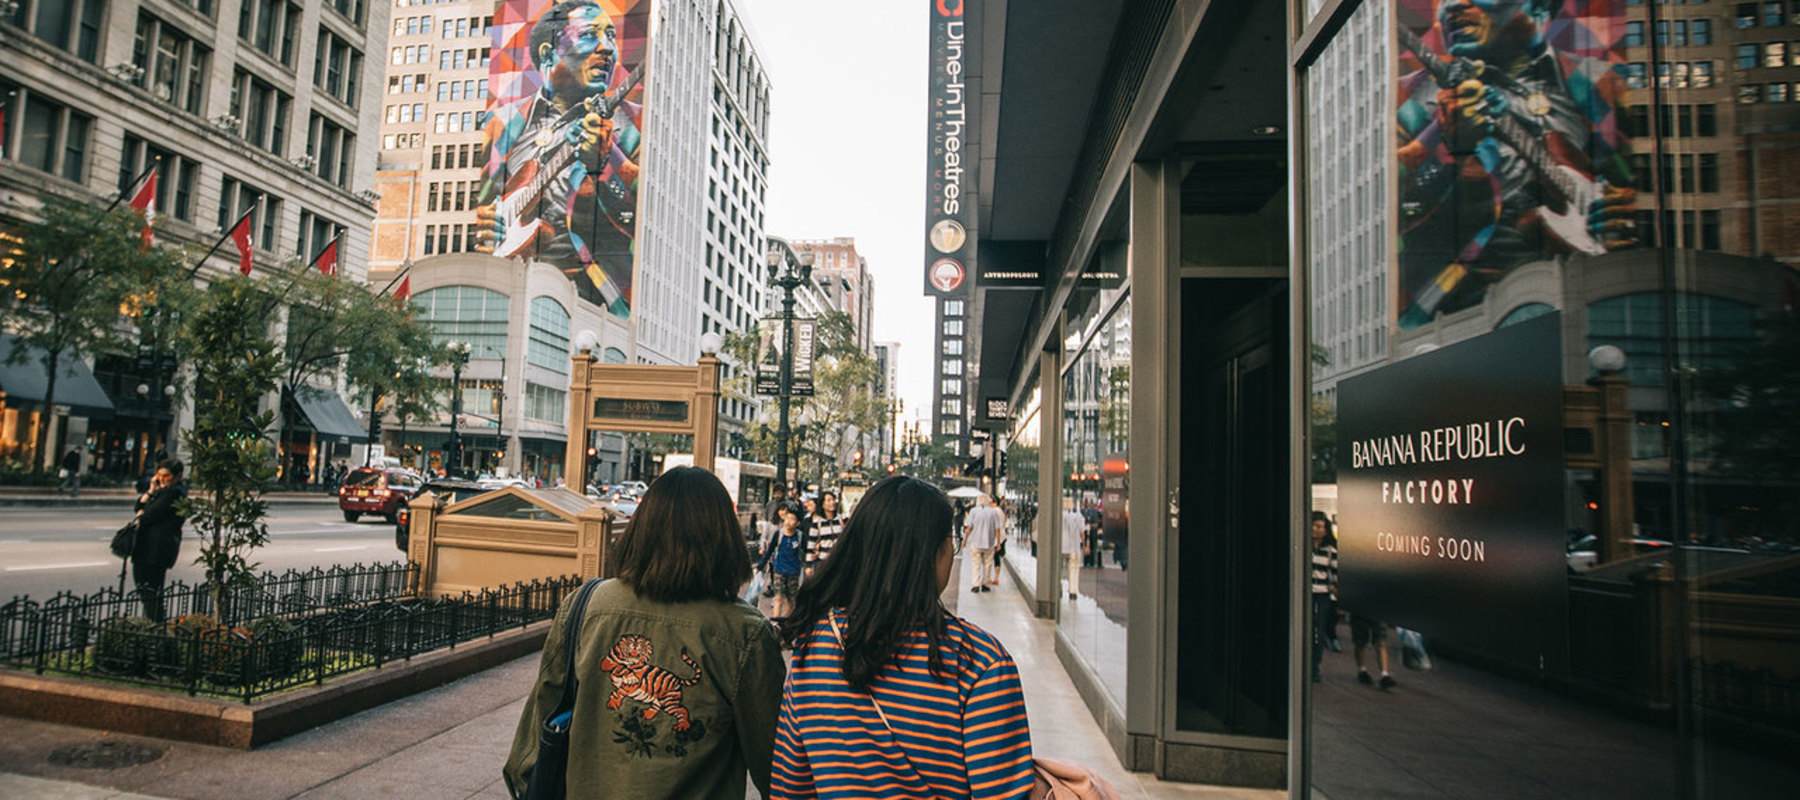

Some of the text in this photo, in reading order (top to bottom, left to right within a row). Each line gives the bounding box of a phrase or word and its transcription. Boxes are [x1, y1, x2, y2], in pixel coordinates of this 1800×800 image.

[935, 98, 943, 156] MENUS
[933, 169, 941, 216] MORE
[623, 401, 661, 411] SUBWAY
[1352, 417, 1525, 469] BANANA REPUBLIC
[1382, 478, 1475, 504] FACTORY
[1377, 532, 1486, 563] COMING SOON
